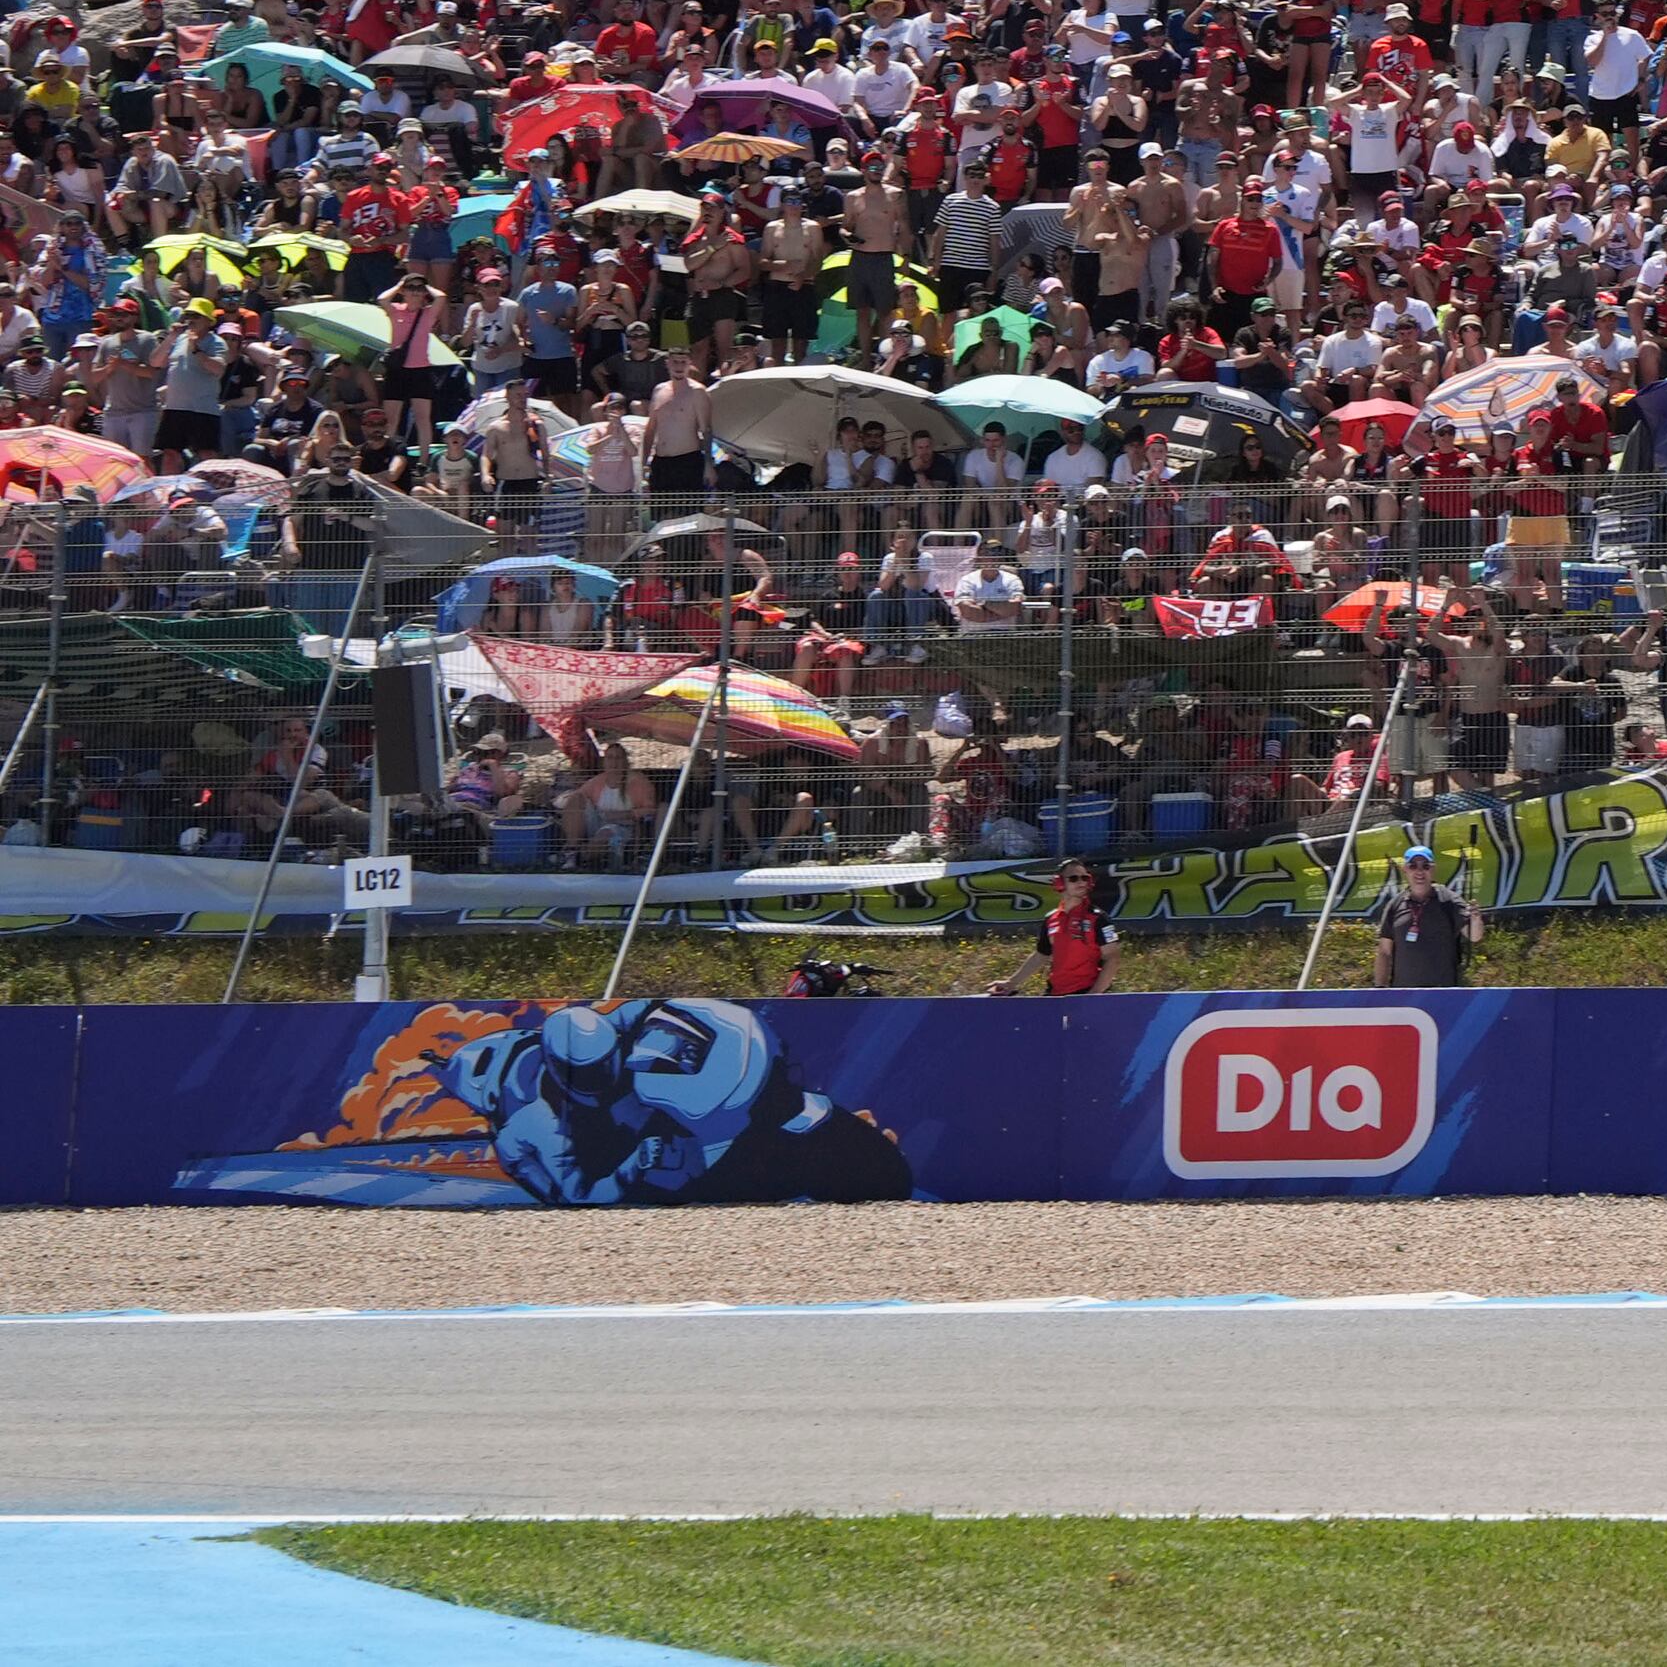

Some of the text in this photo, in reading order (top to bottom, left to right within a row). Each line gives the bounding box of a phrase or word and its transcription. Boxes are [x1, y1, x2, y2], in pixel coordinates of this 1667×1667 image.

[1131, 395, 1190, 406] GOODYEAR
[1200, 600, 1257, 628] 93
[354, 868, 400, 892] LC12
